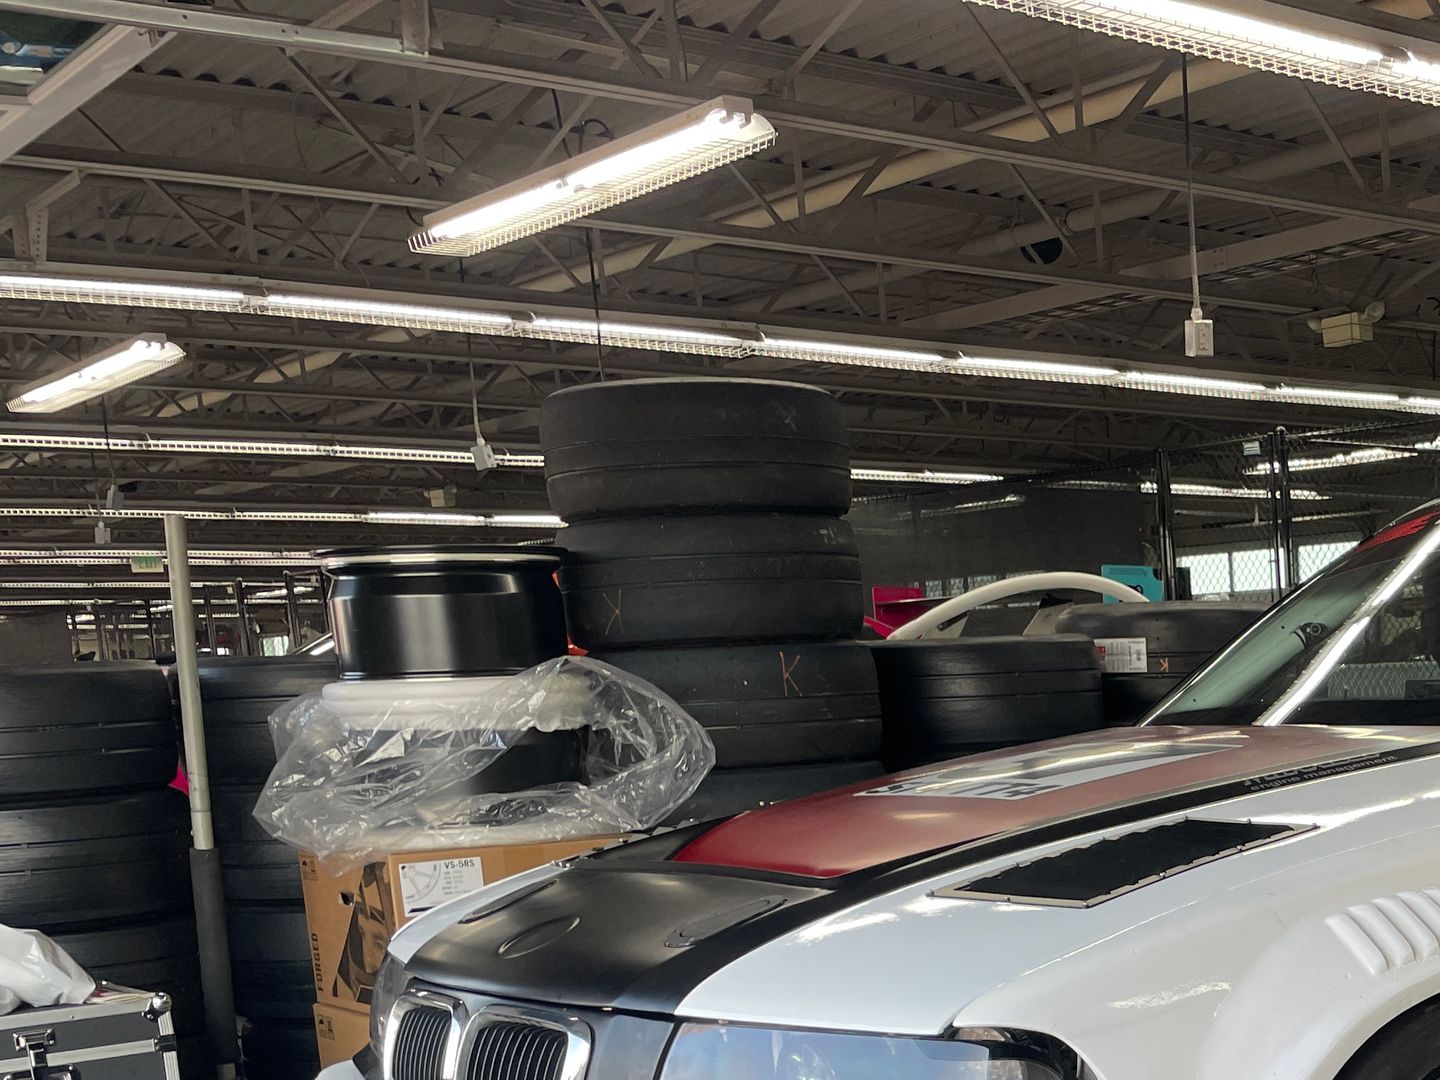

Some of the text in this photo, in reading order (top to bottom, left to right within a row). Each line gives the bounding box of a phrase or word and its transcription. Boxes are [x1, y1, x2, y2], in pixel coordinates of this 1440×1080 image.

[777, 650, 803, 697] K
[1250, 776, 1301, 791] engine
[1303, 755, 1399, 781] management
[311, 932, 324, 992] FORGED
